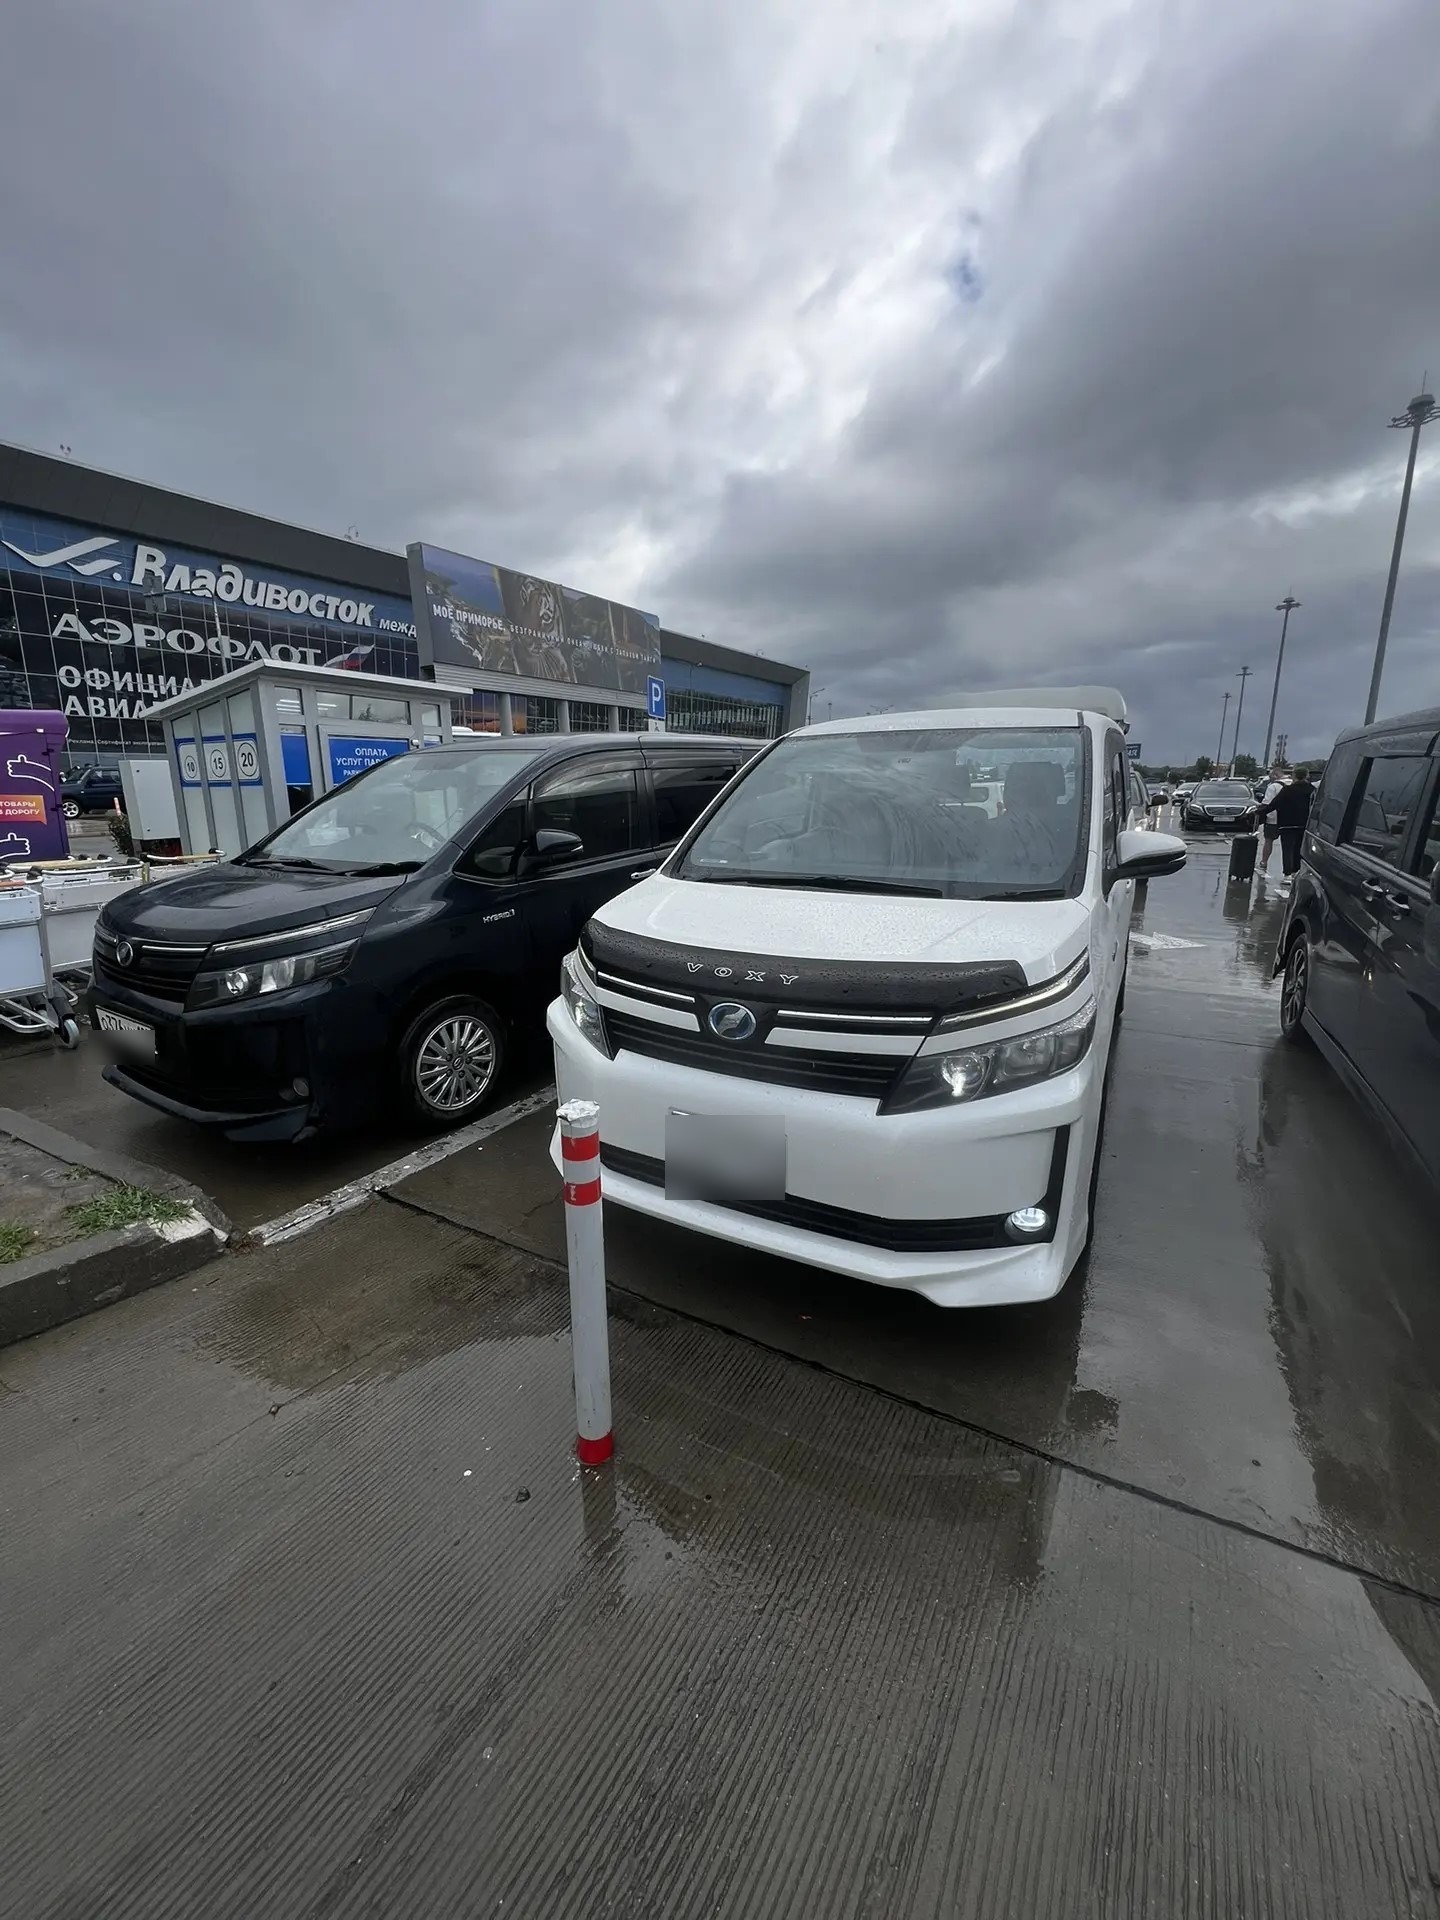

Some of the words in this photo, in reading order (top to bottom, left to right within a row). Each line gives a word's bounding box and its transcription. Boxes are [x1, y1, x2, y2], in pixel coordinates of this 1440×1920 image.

[52, 613, 321, 665] АЭРОФЛОТ
[652, 682, 661, 713] P
[355, 747, 388, 757] ОПЛАТА
[187, 761, 195, 772] 10
[213, 757, 223, 770] 15
[241, 752, 254, 767] 20
[336, 757, 361, 766] УСЛУГ
[687, 962, 800, 985] VOXY
